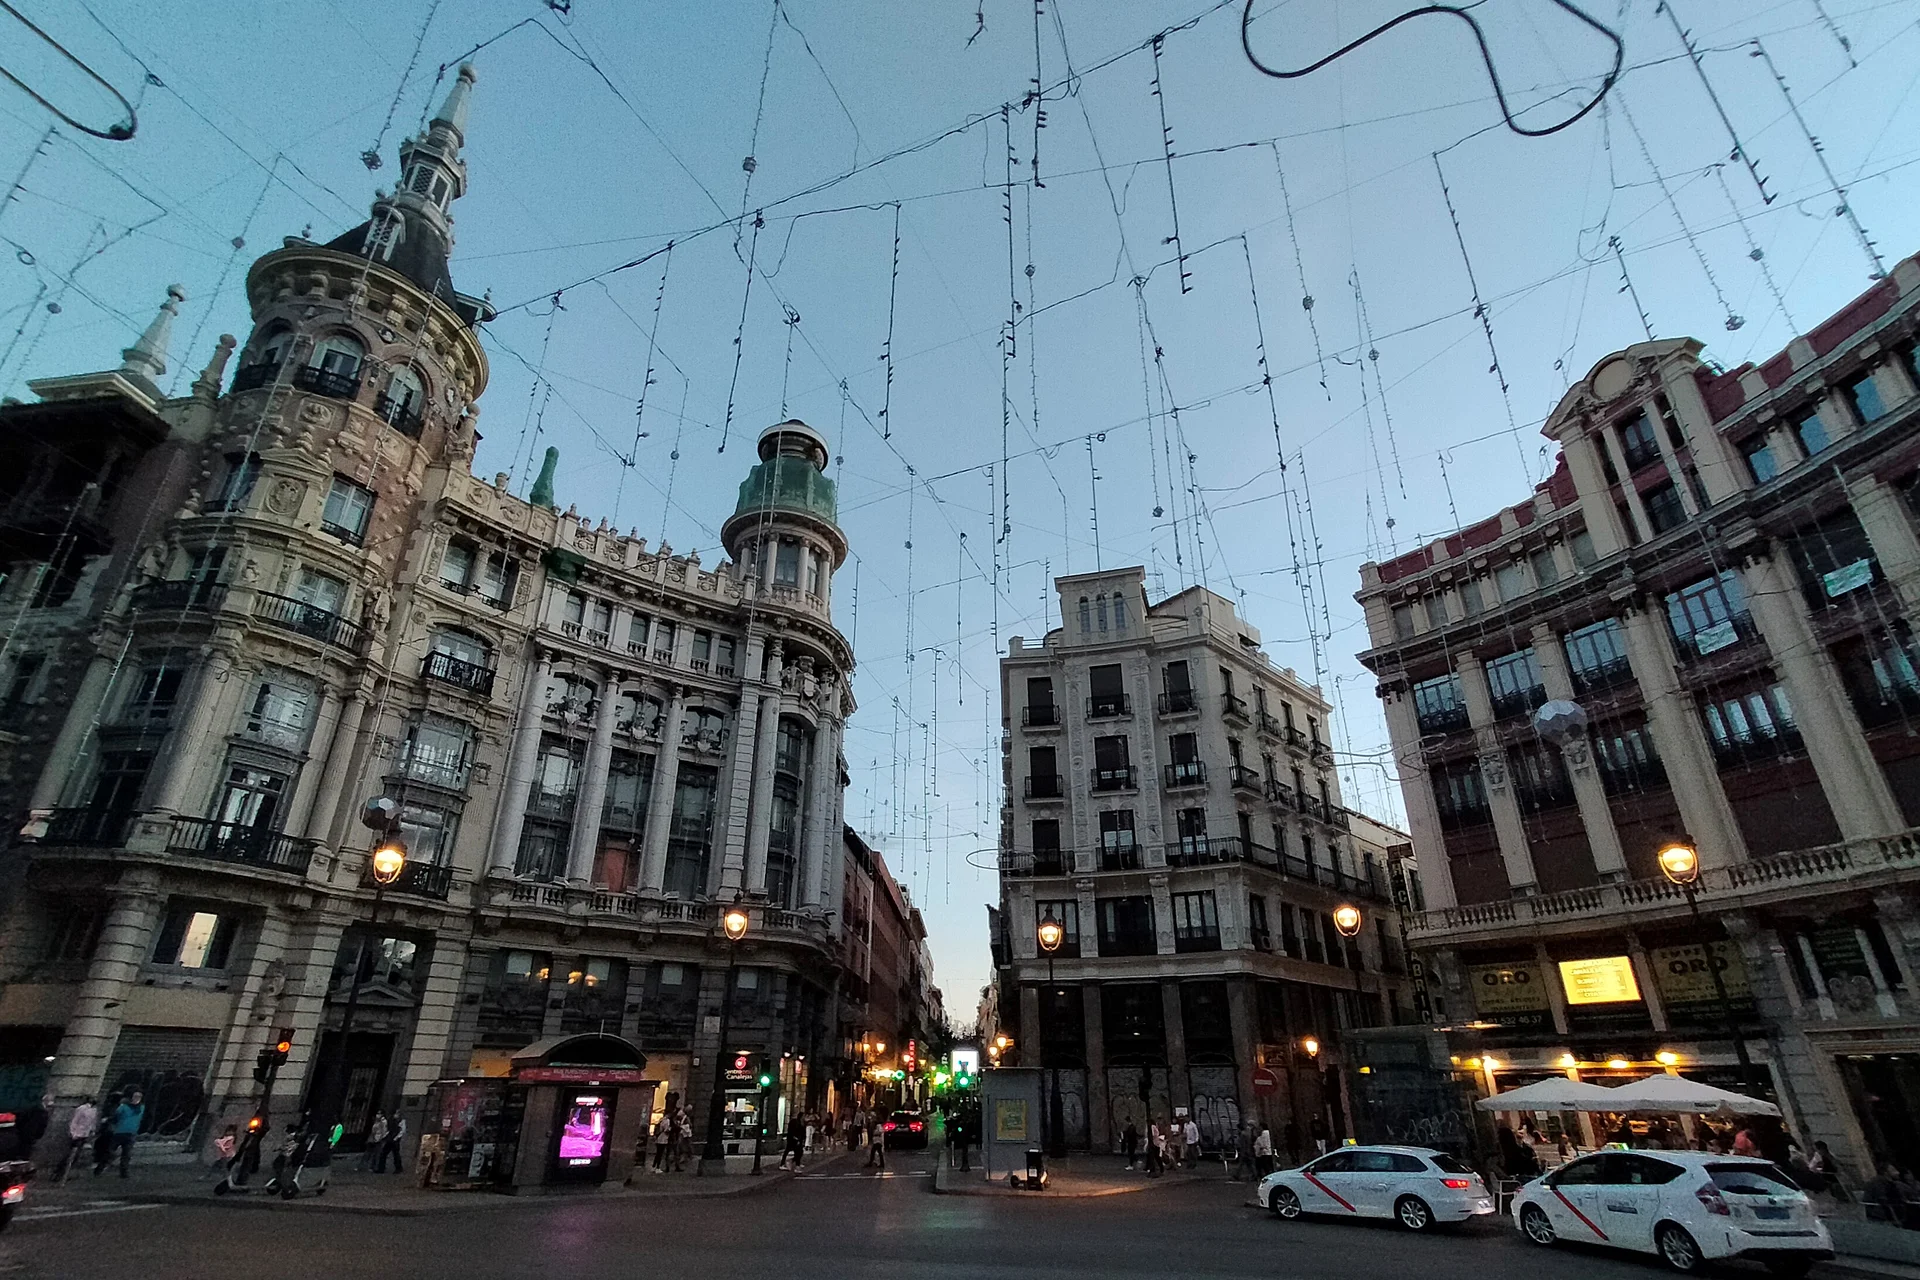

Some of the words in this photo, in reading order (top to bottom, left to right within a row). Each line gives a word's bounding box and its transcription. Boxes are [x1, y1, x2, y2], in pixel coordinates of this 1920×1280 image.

[1659, 944, 1727, 959] EMPEO
[1500, 1016, 1517, 1025] 532
[1531, 1014, 1543, 1024] 37
